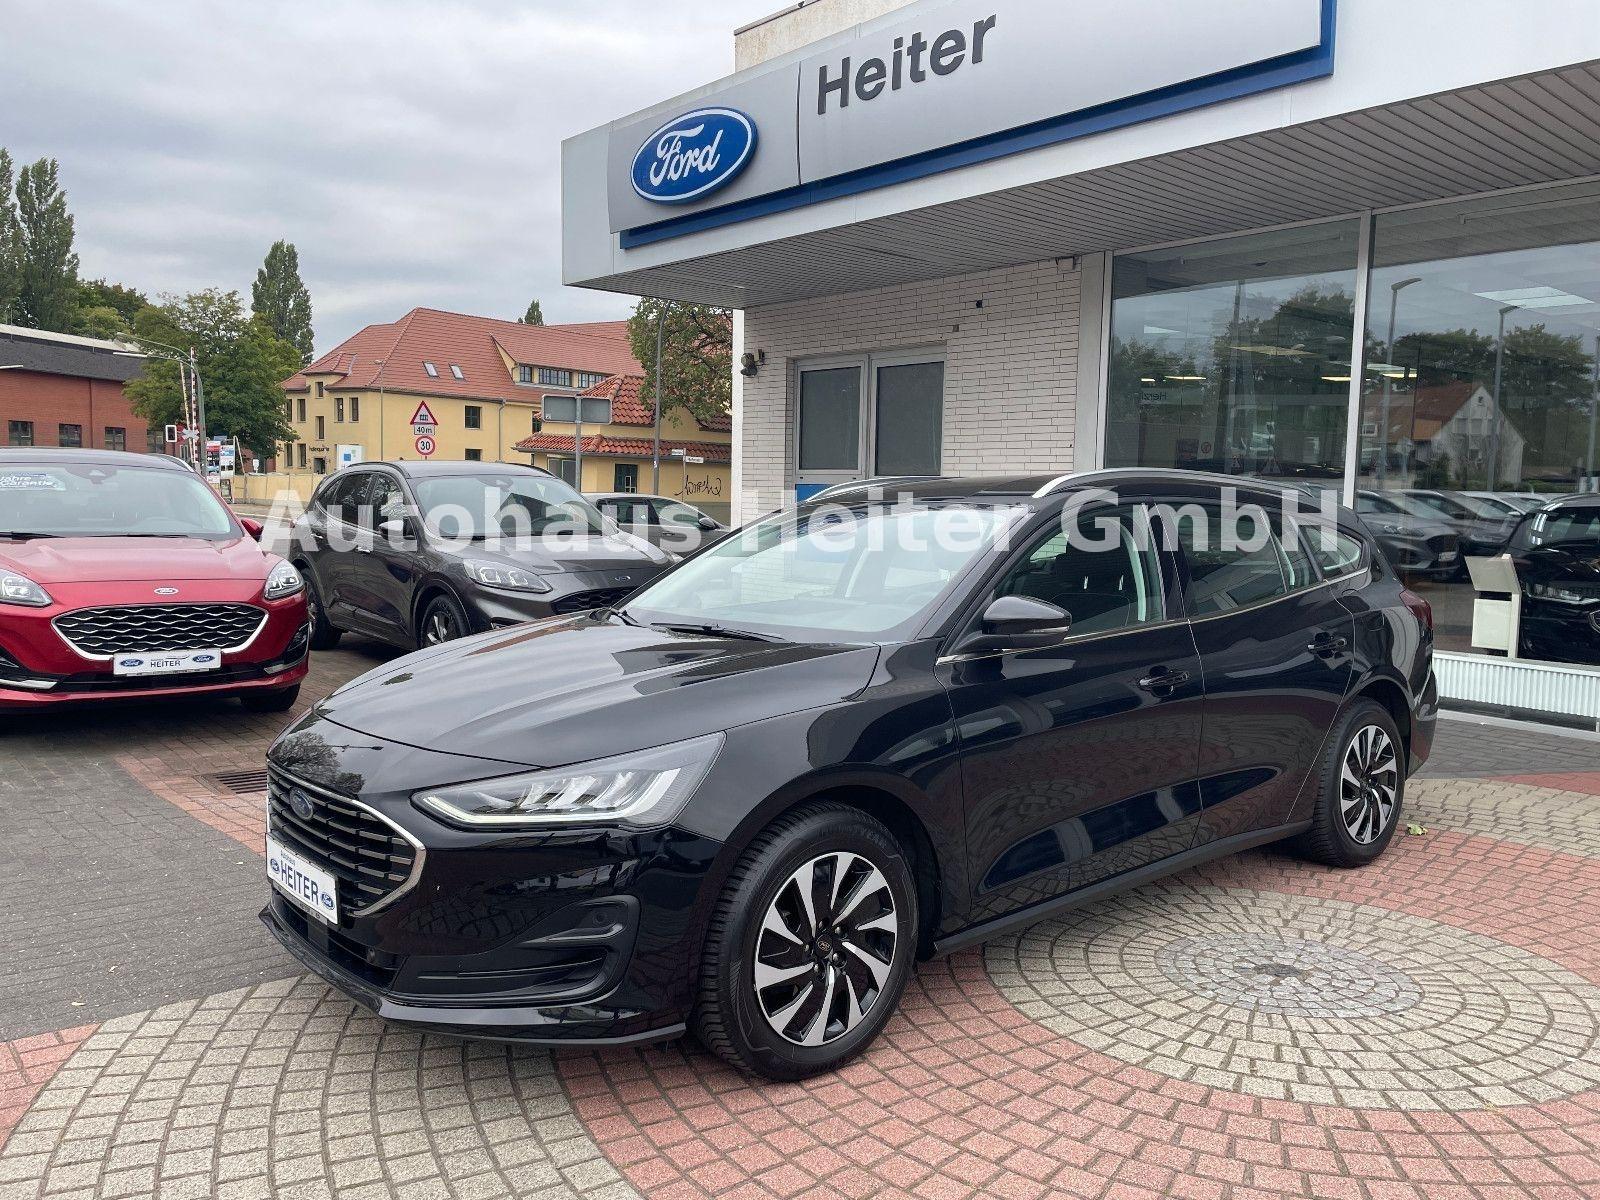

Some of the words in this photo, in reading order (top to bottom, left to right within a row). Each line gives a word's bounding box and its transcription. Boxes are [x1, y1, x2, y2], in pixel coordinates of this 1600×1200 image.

[817, 14, 997, 115] Heiter
[649, 122, 725, 188] Ford
[420, 440, 431, 451] 30
[150, 660, 181, 668] HEITER
[280, 860, 319, 906] HEITER
